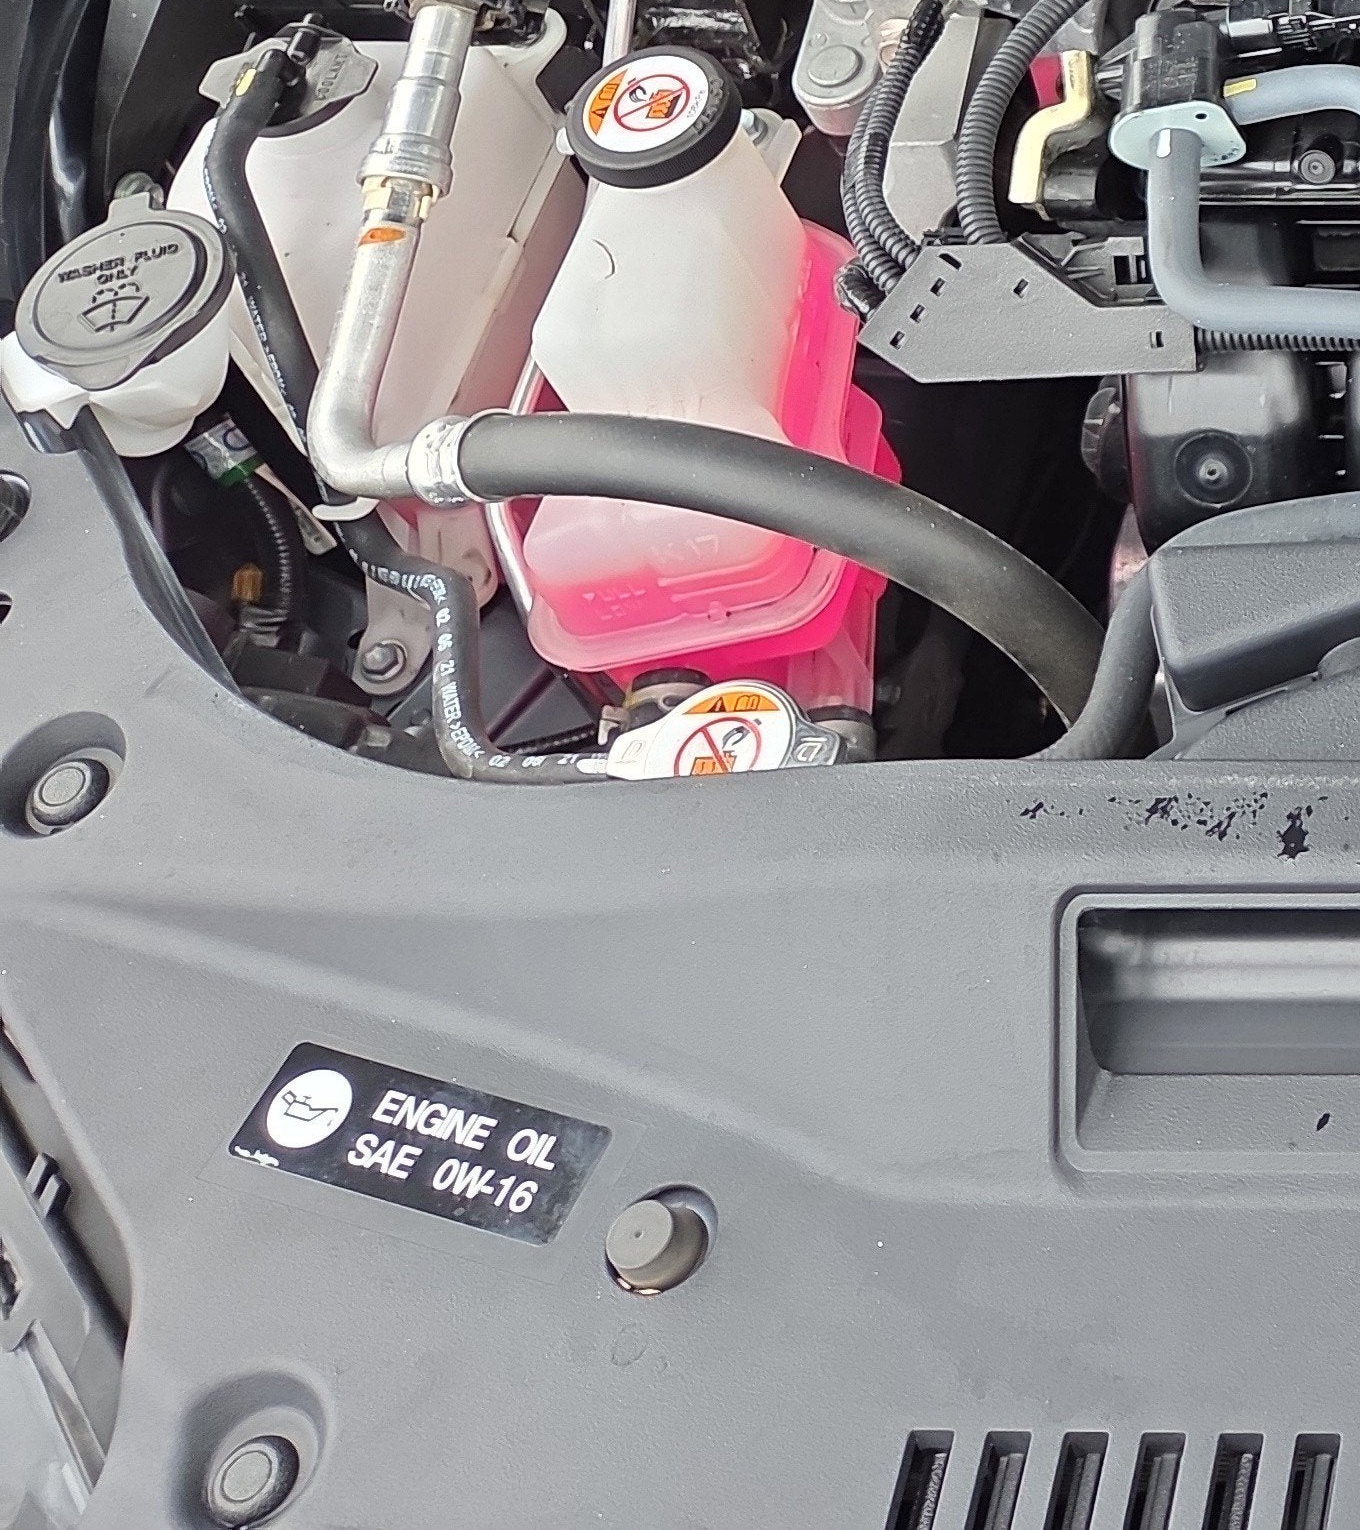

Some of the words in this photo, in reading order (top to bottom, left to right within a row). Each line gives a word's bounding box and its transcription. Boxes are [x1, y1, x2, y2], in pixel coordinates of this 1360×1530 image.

[57, 256, 126, 284] WASHER
[133, 242, 180, 263] FLUID
[96, 265, 139, 286] ONLY
[441, 681, 462, 723] WATER
[371, 1089, 498, 1151] ENGINE
[506, 1127, 558, 1172] OIL
[346, 1133, 423, 1179] SAE
[431, 1158, 539, 1214] 0W-16
